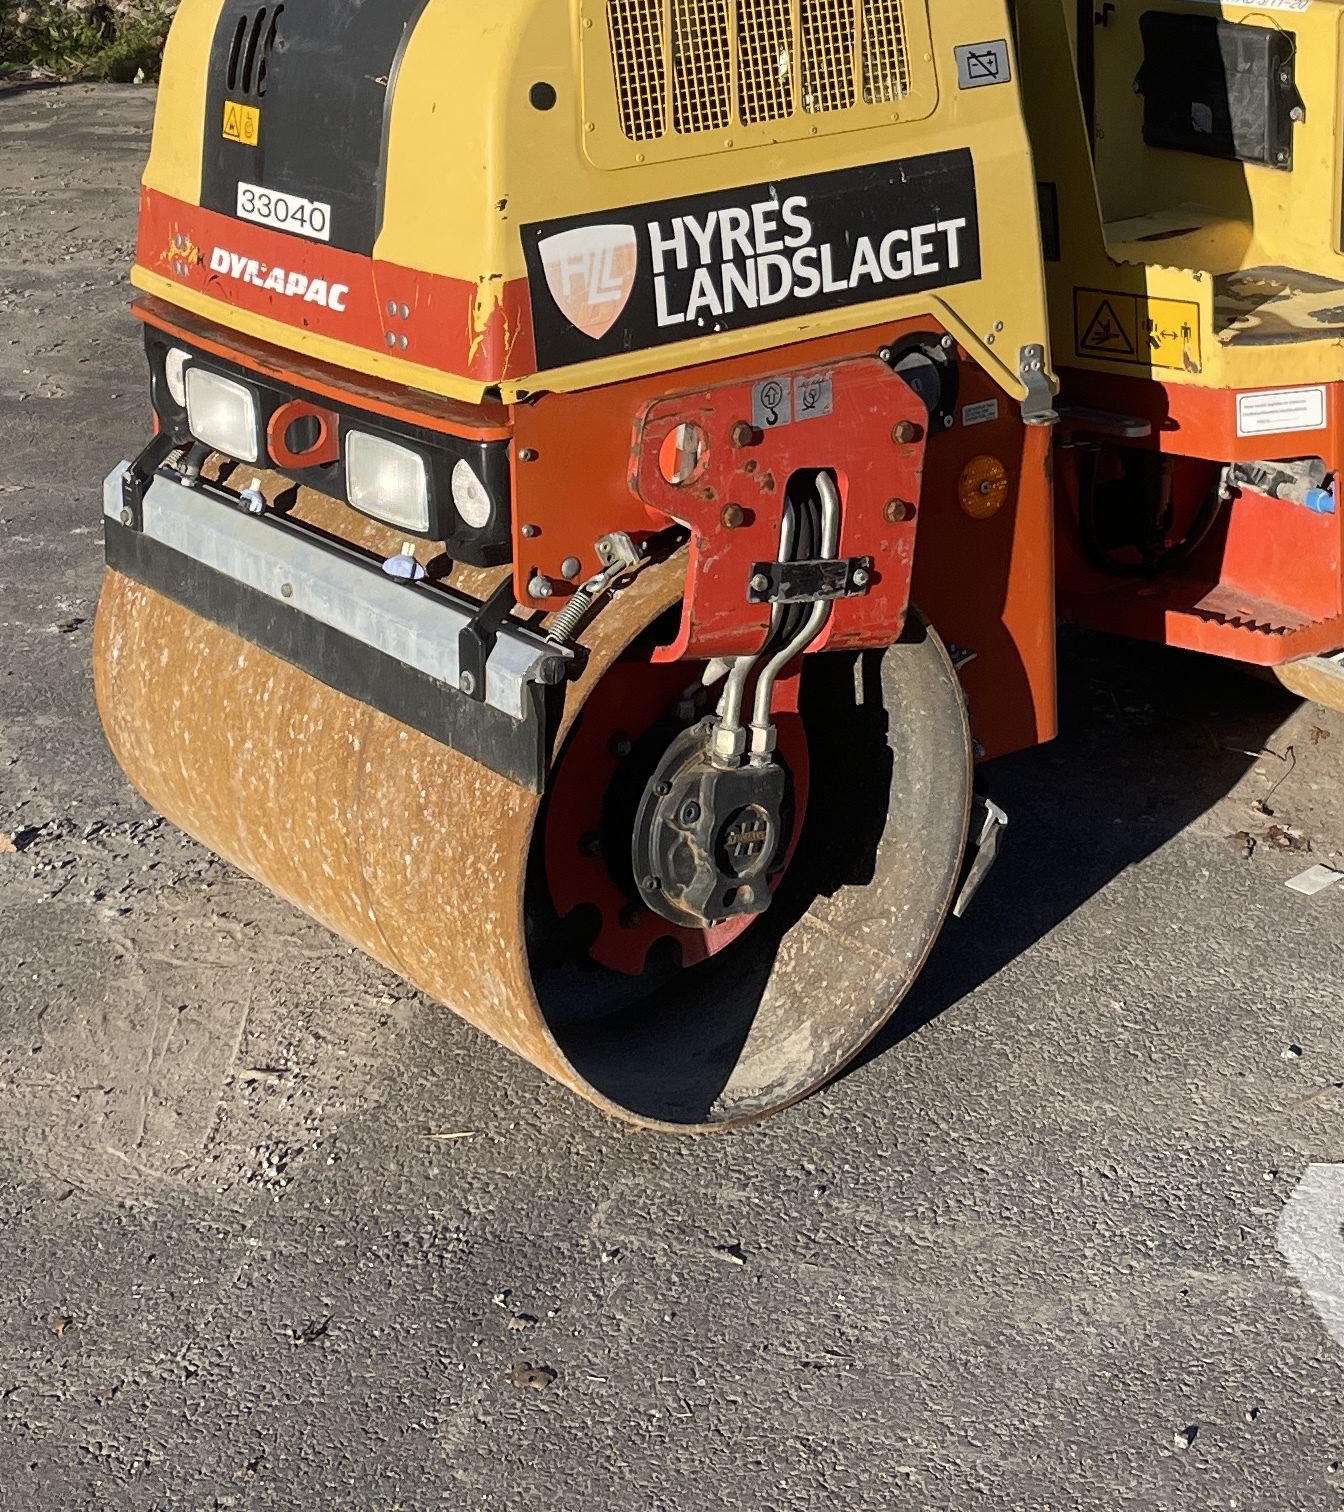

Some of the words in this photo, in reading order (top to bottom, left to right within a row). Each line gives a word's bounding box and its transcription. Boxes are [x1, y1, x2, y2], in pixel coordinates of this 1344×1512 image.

[240, 187, 327, 234] 33040
[648, 195, 812, 276] HYRES
[209, 246, 349, 312] DYNAPAC
[652, 217, 967, 328] LANDSLAGET
